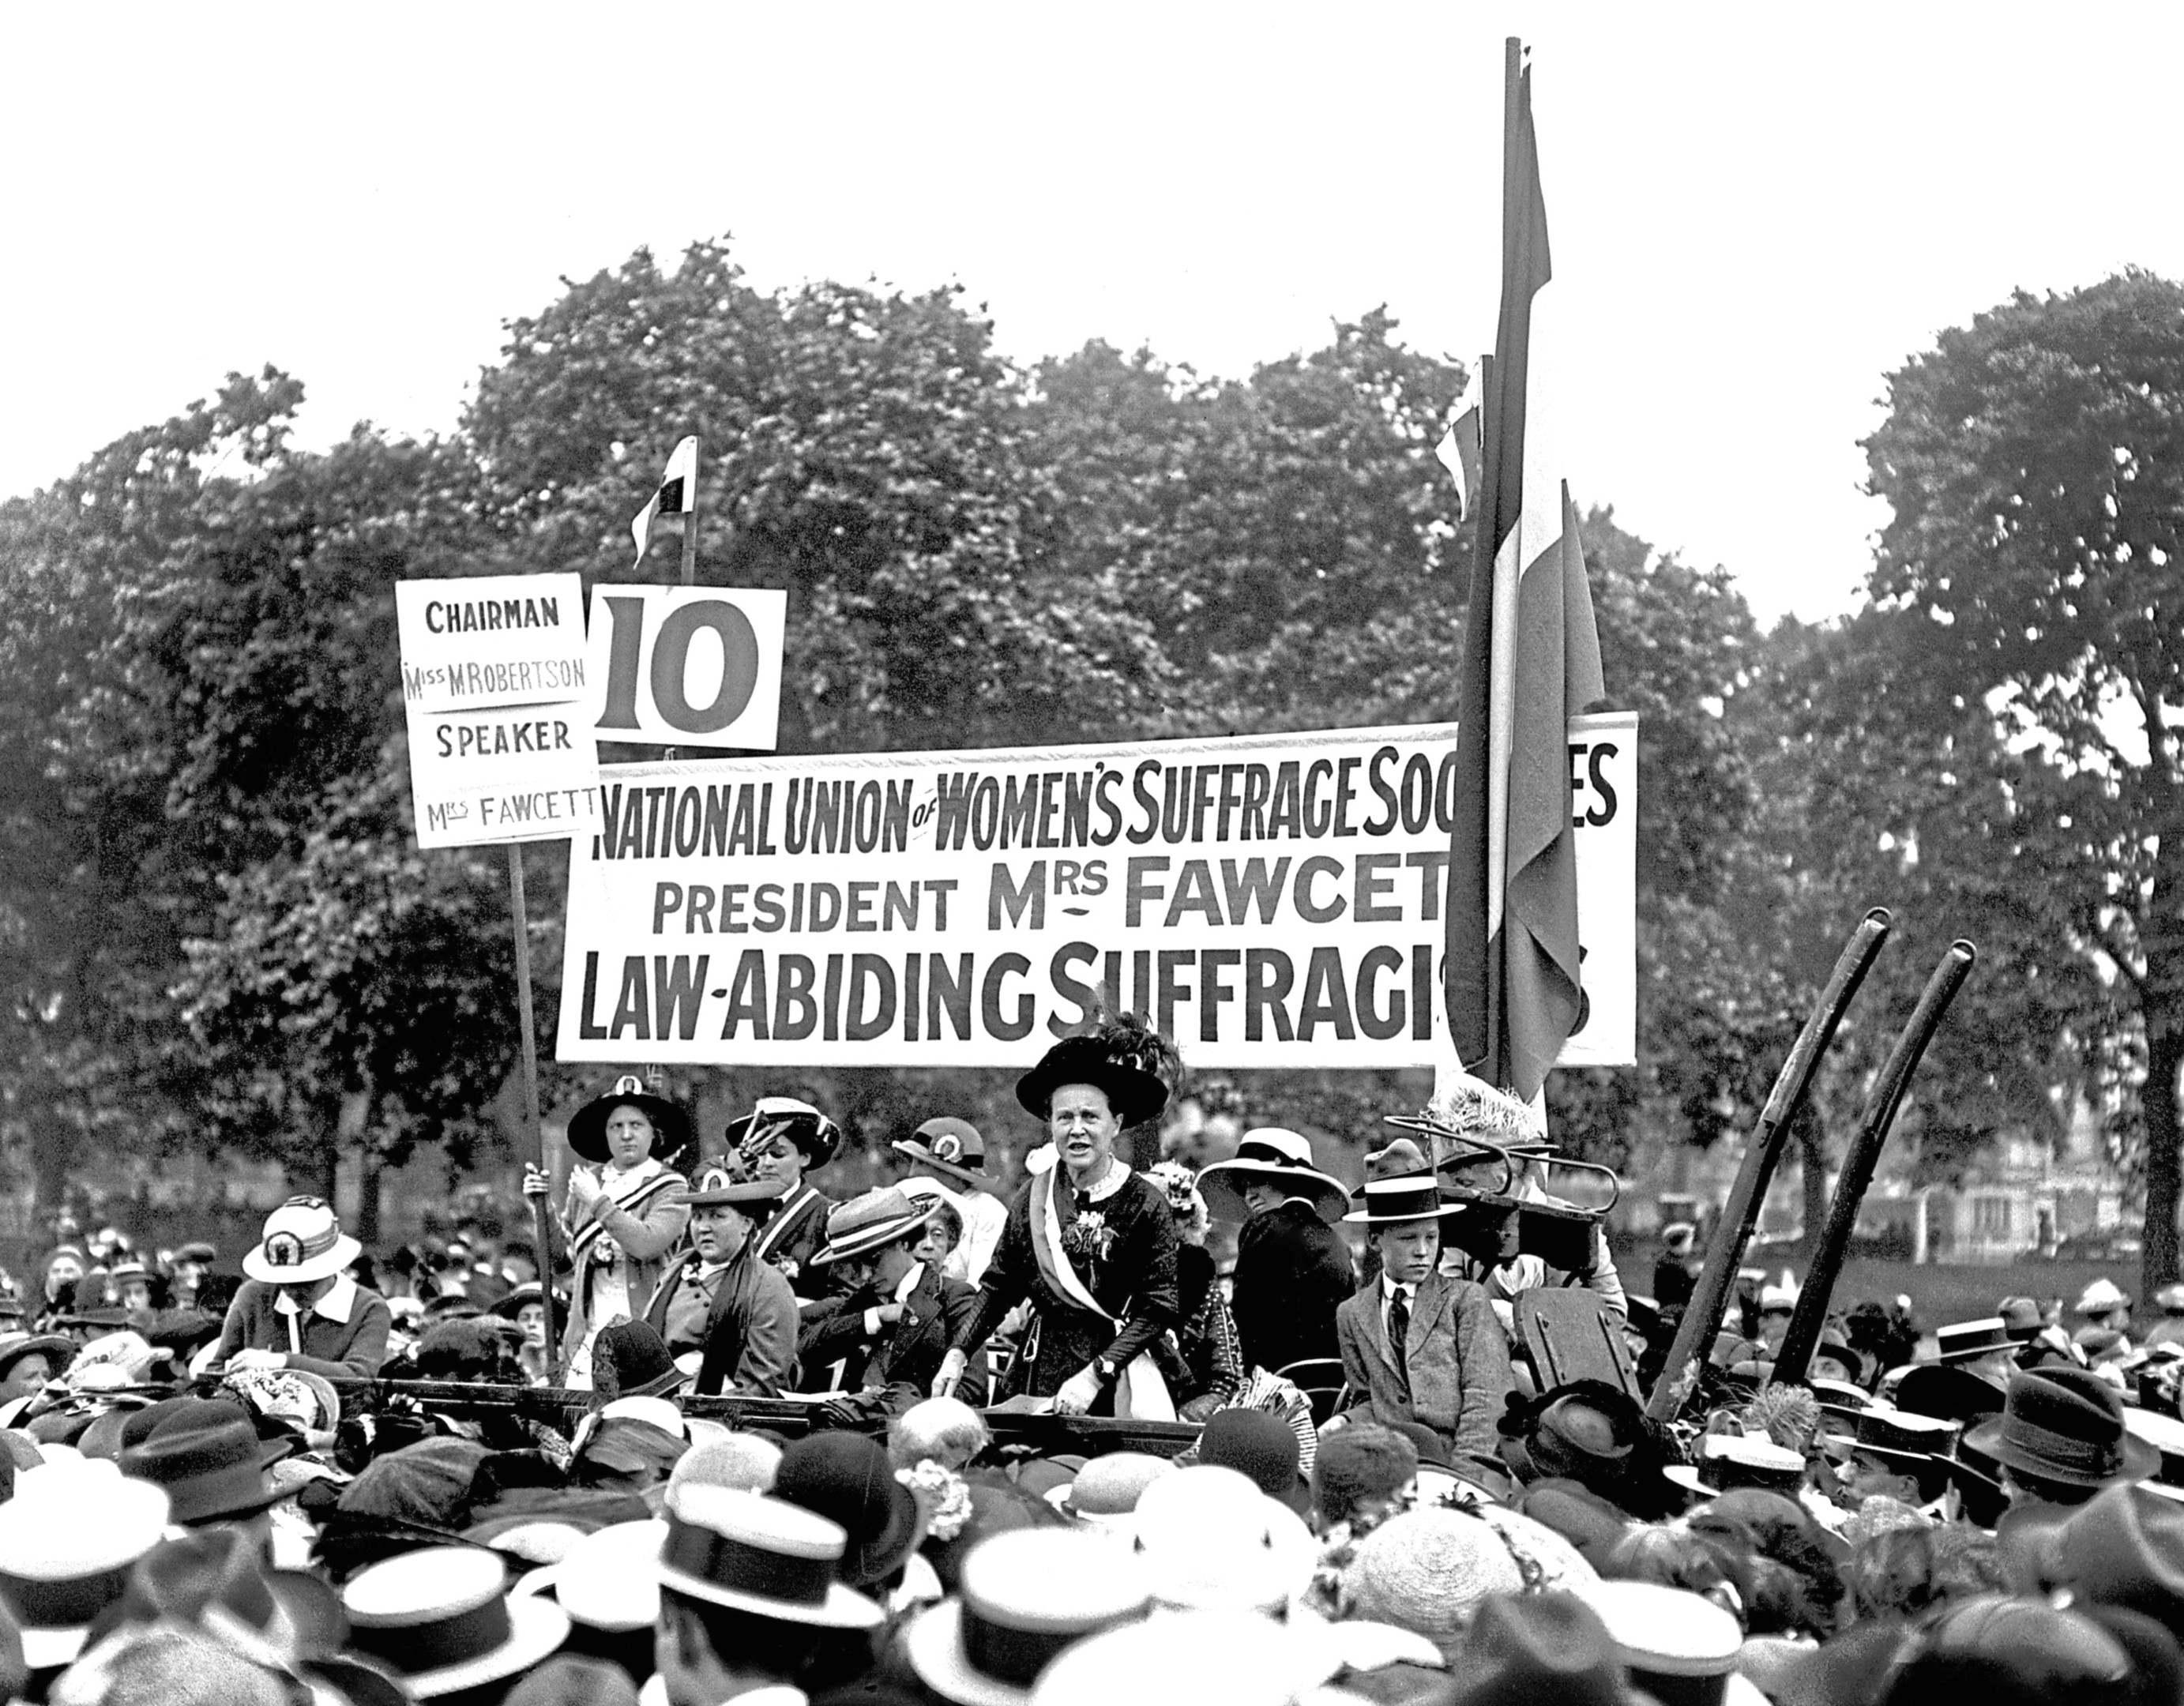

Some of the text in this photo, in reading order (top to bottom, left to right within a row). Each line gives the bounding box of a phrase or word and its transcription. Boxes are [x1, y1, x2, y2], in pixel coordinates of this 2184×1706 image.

[426, 597, 559, 633] CHAIRMAN
[594, 596, 759, 734] 10
[437, 721, 573, 757] SPEAKER
[480, 787, 596, 825] FAWCETT
[592, 782, 776, 861] NATIONAL
[784, 777, 913, 855] UNION
[935, 761, 1123, 851] WOMEN'S
[1126, 759, 1362, 845] SUFFRAGE
[652, 879, 958, 934] PRESIDENT
[580, 949, 1036, 1042] LAW-ABIDING
